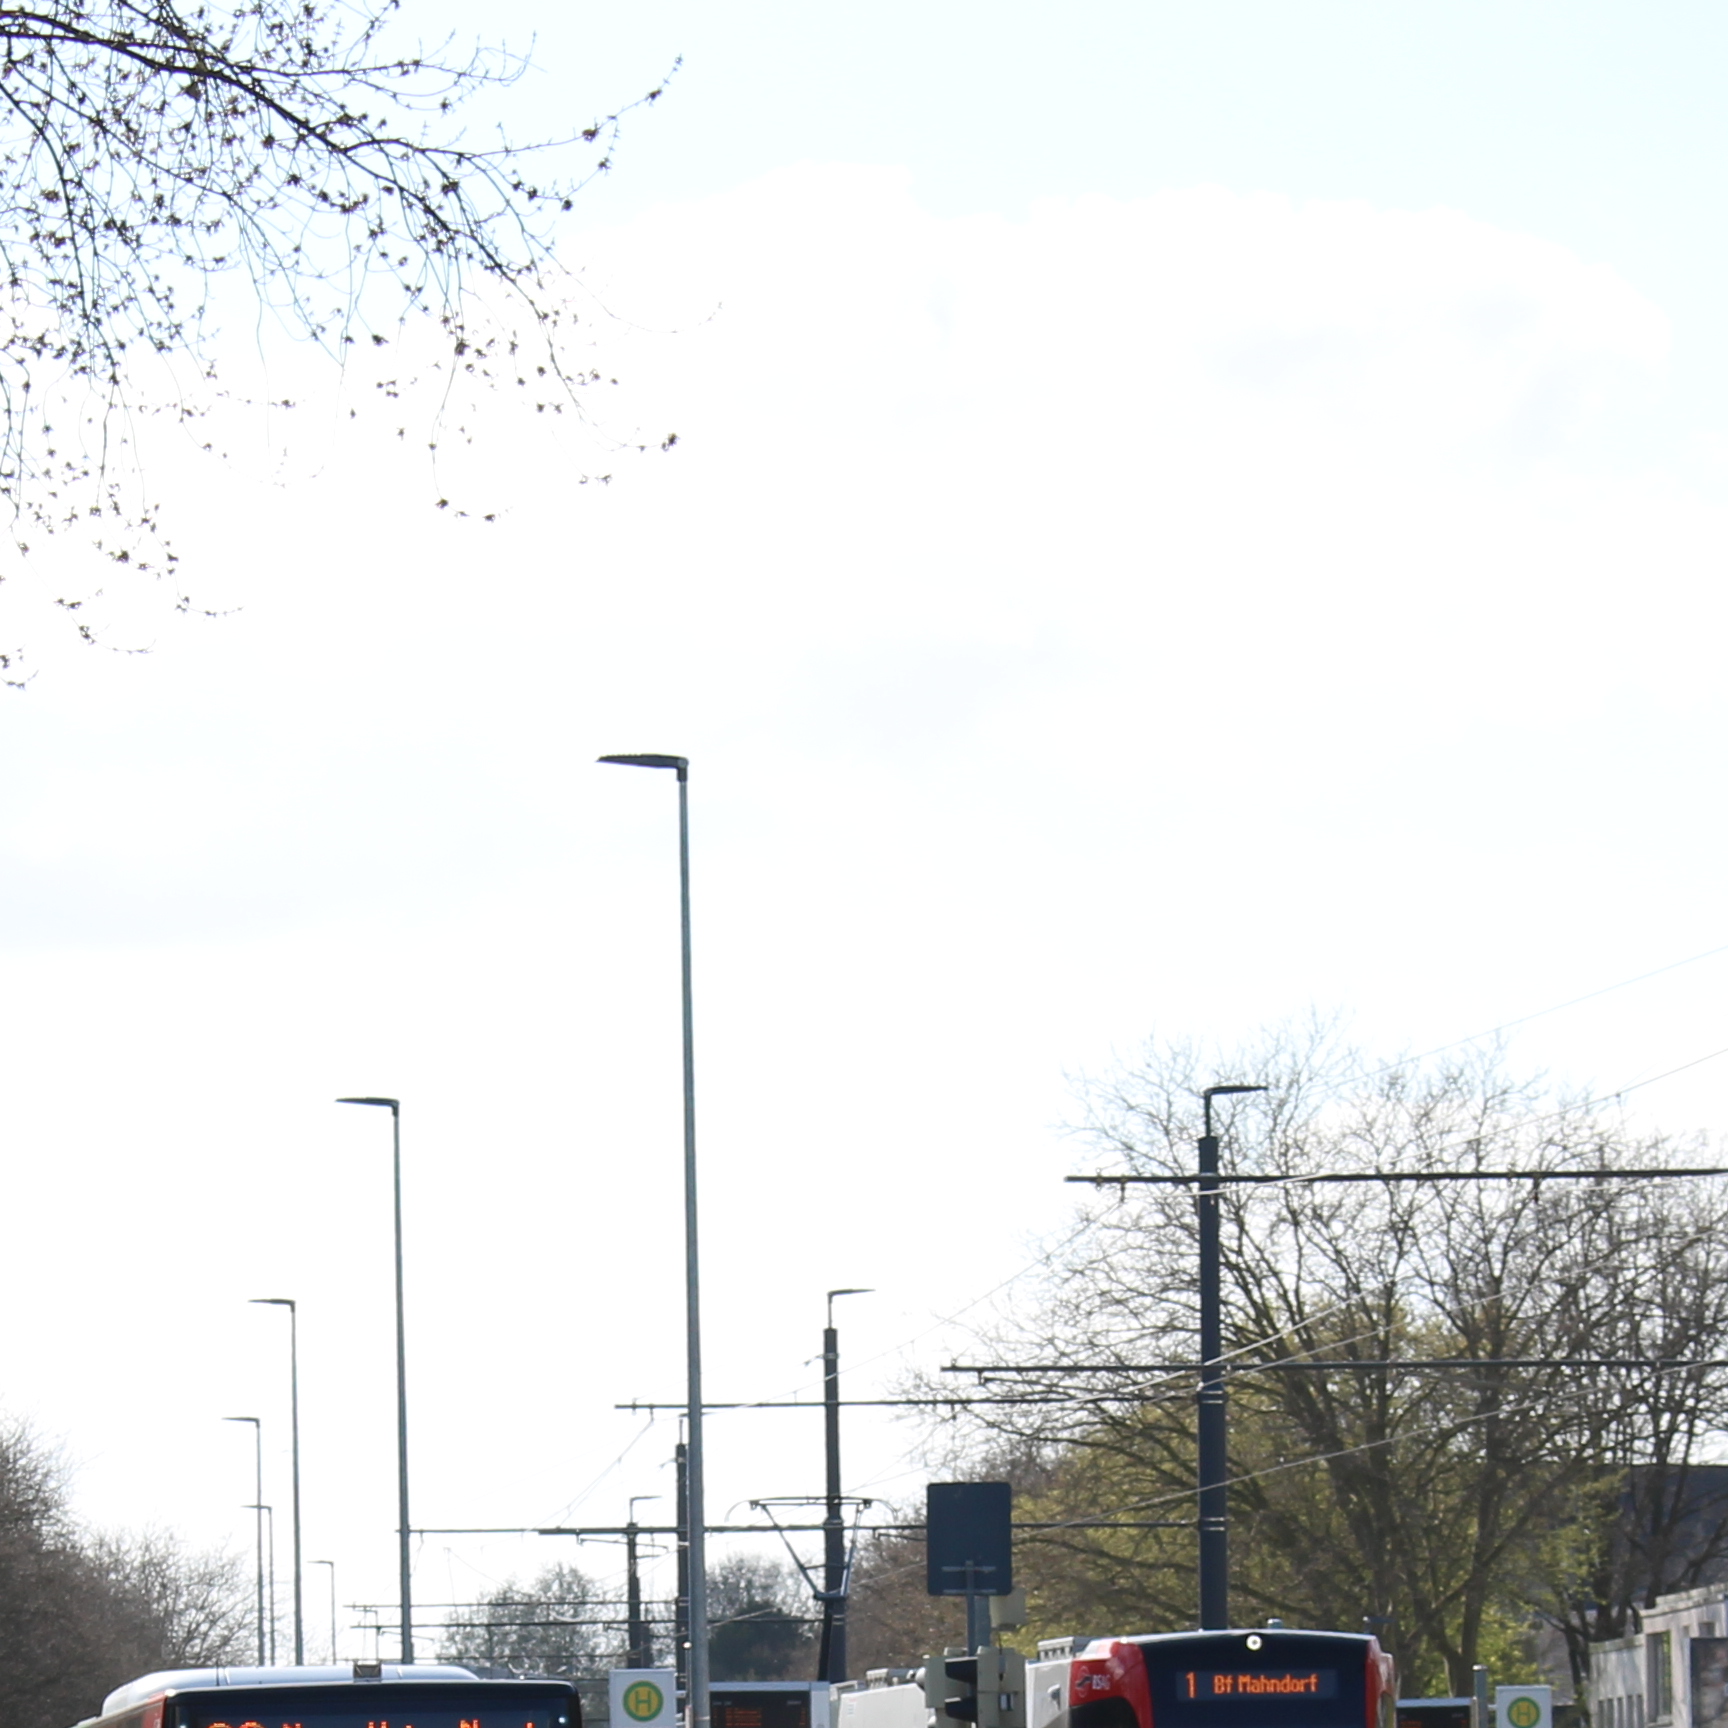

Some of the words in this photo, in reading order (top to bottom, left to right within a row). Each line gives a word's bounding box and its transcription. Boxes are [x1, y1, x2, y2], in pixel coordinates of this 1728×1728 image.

[1186, 1672, 1196, 1698] 1
[1214, 1675, 1233, 1694] Bf
[1238, 1674, 1318, 1693] Mahndorf
[635, 1690, 651, 1713] H
